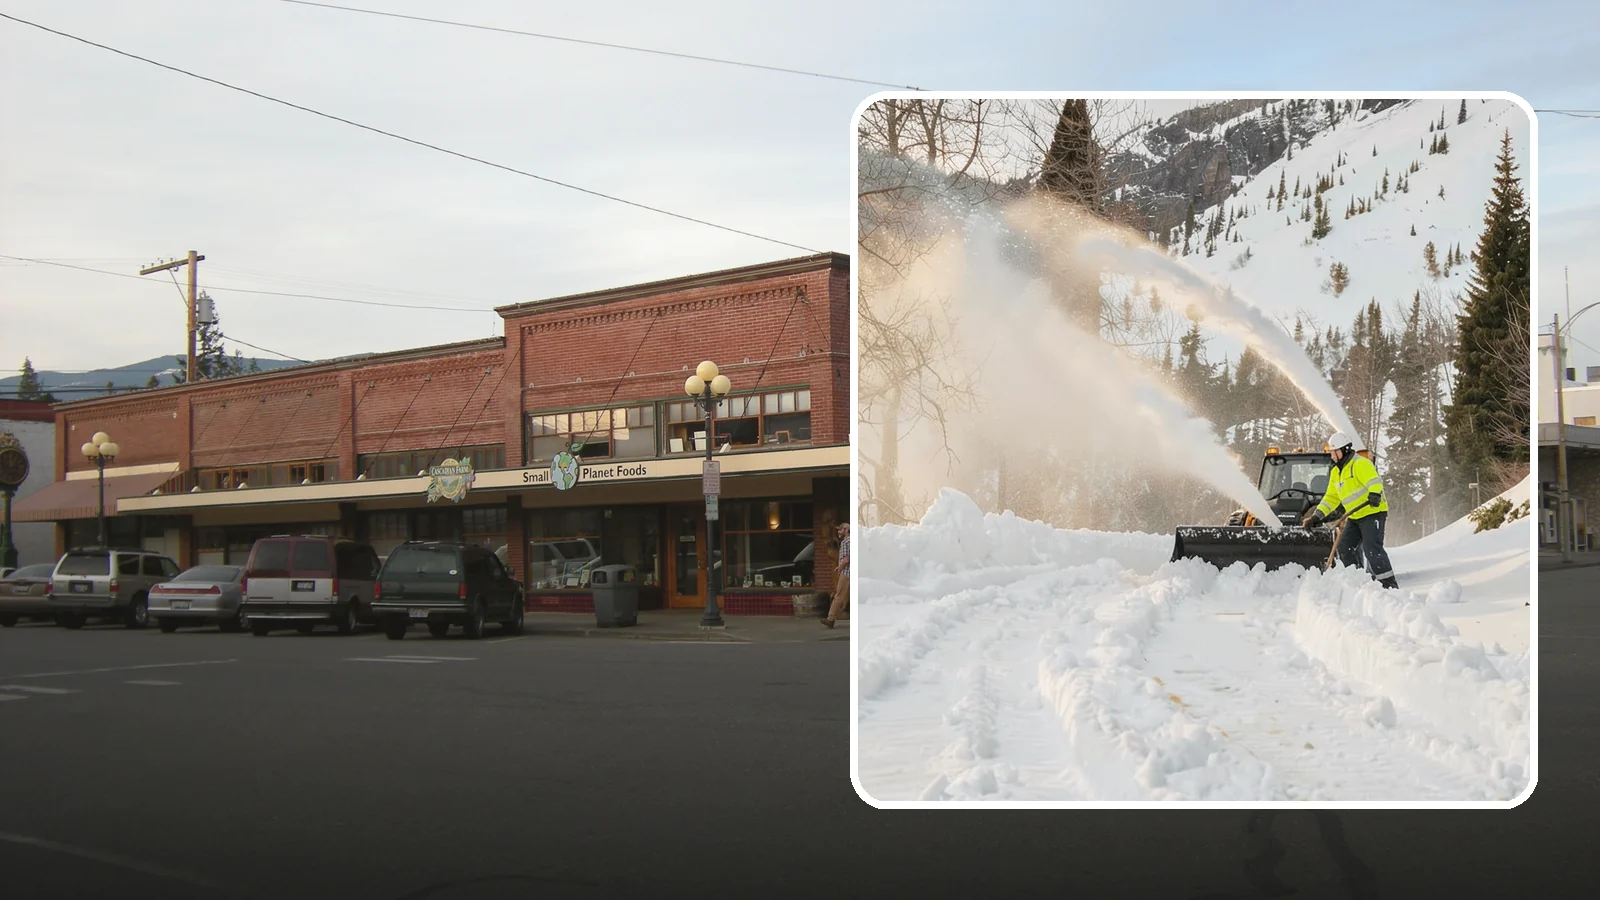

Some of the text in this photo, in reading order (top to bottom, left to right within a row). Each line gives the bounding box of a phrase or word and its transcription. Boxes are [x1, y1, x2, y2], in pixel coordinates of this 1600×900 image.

[523, 464, 647, 483] Small Planet Foods
